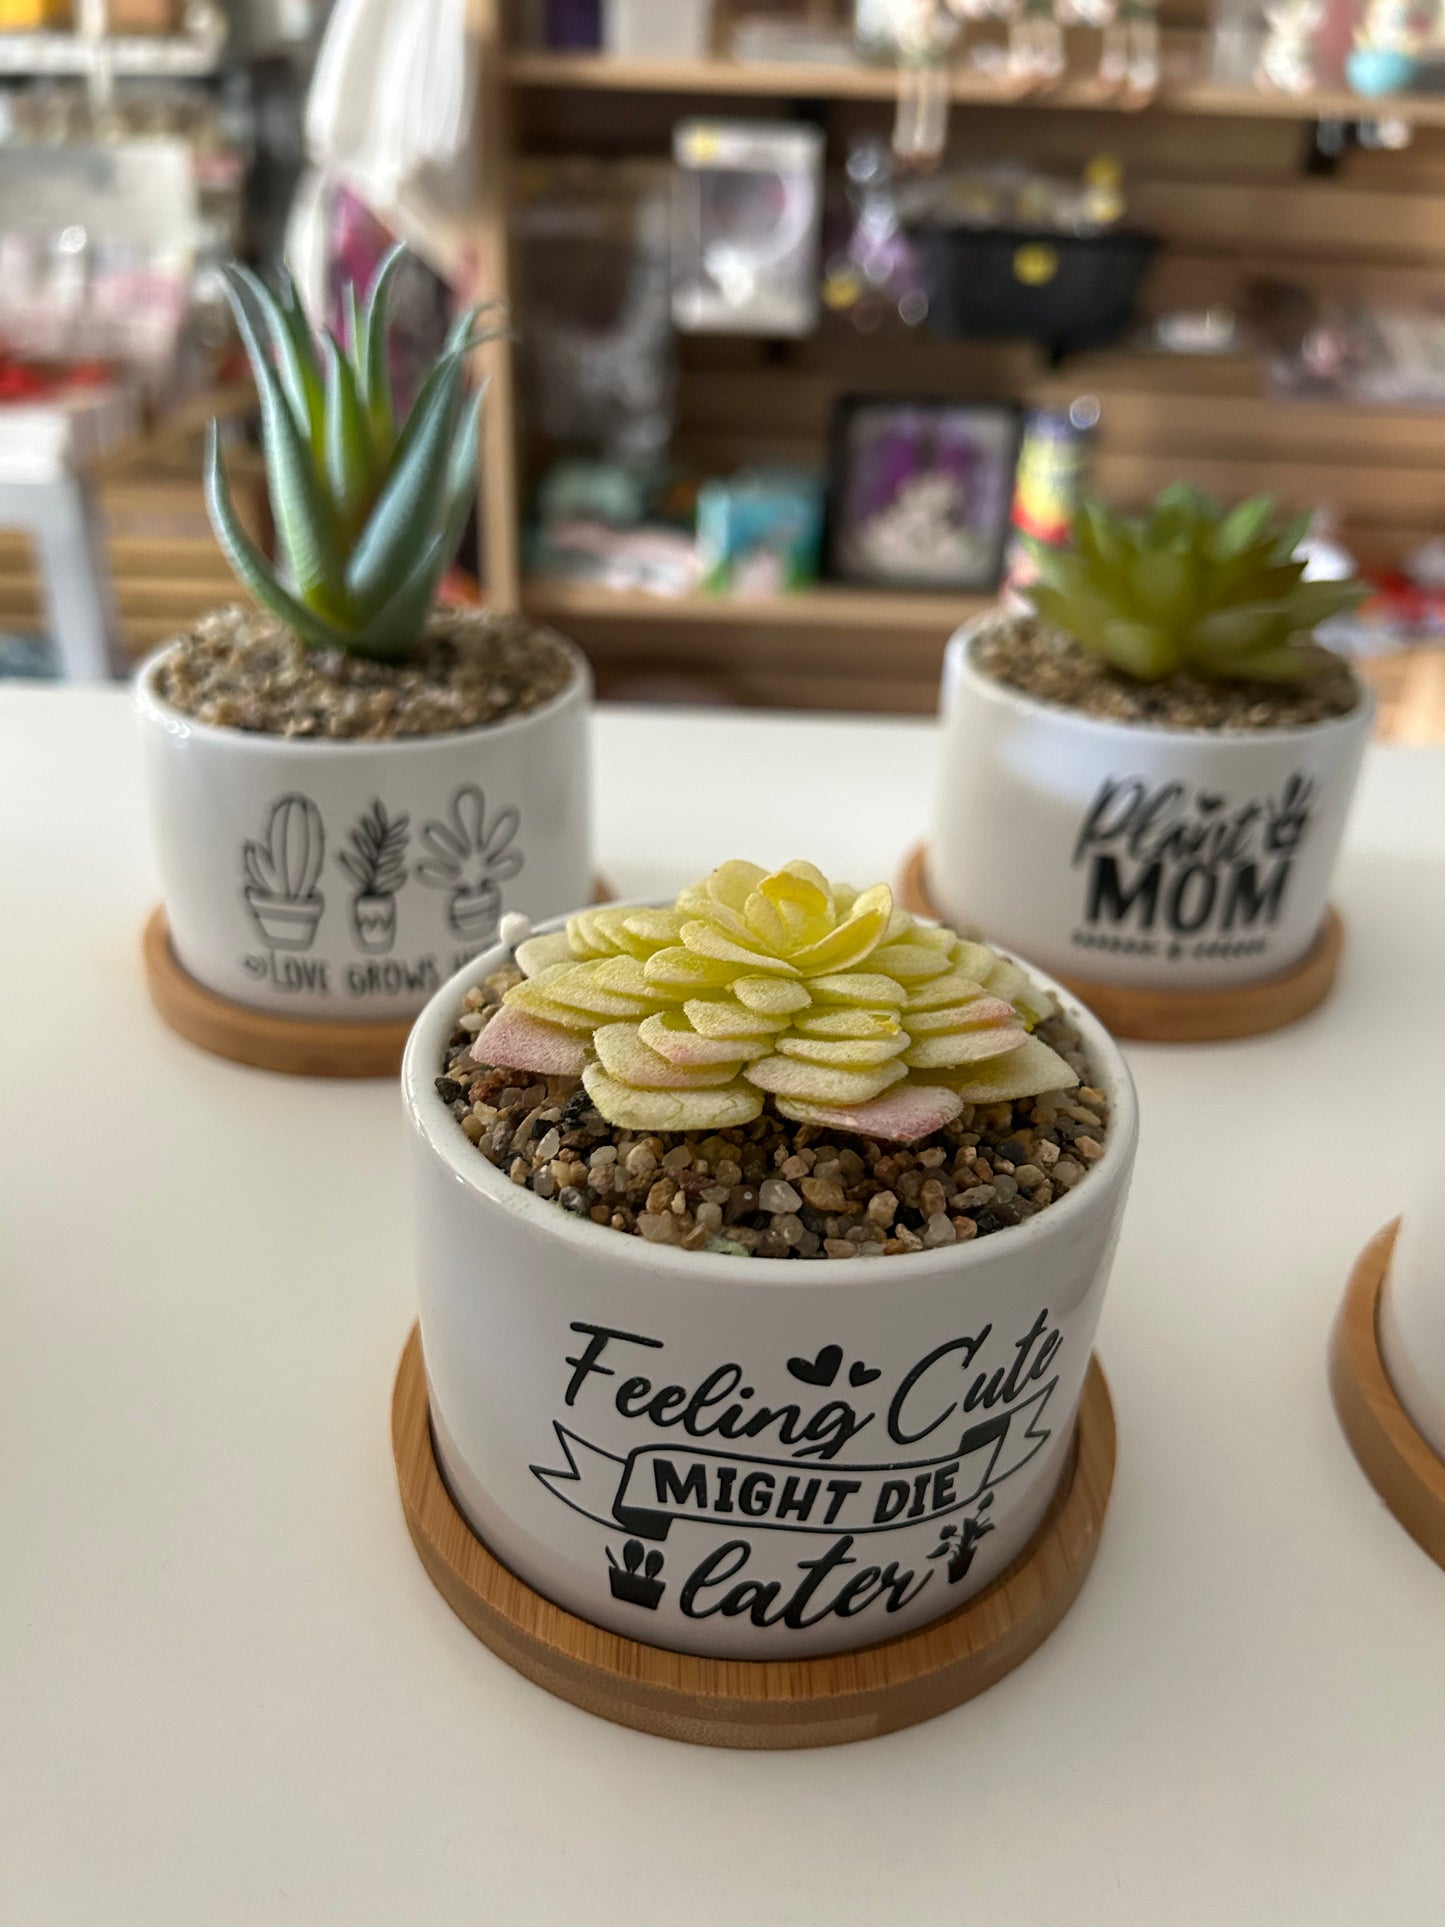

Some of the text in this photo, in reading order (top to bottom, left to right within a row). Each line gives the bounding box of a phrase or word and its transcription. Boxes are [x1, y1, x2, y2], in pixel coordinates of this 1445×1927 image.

[1071, 774, 1261, 869] Plant
[1086, 855, 1290, 933] MOM
[271, 950, 328, 993] LOVE
[347, 954, 440, 995] GROWS
[566, 1308, 1063, 1459] Feeling Cute
[653, 1458, 960, 1525] MIGHT DIE
[680, 1535, 934, 1629] later
